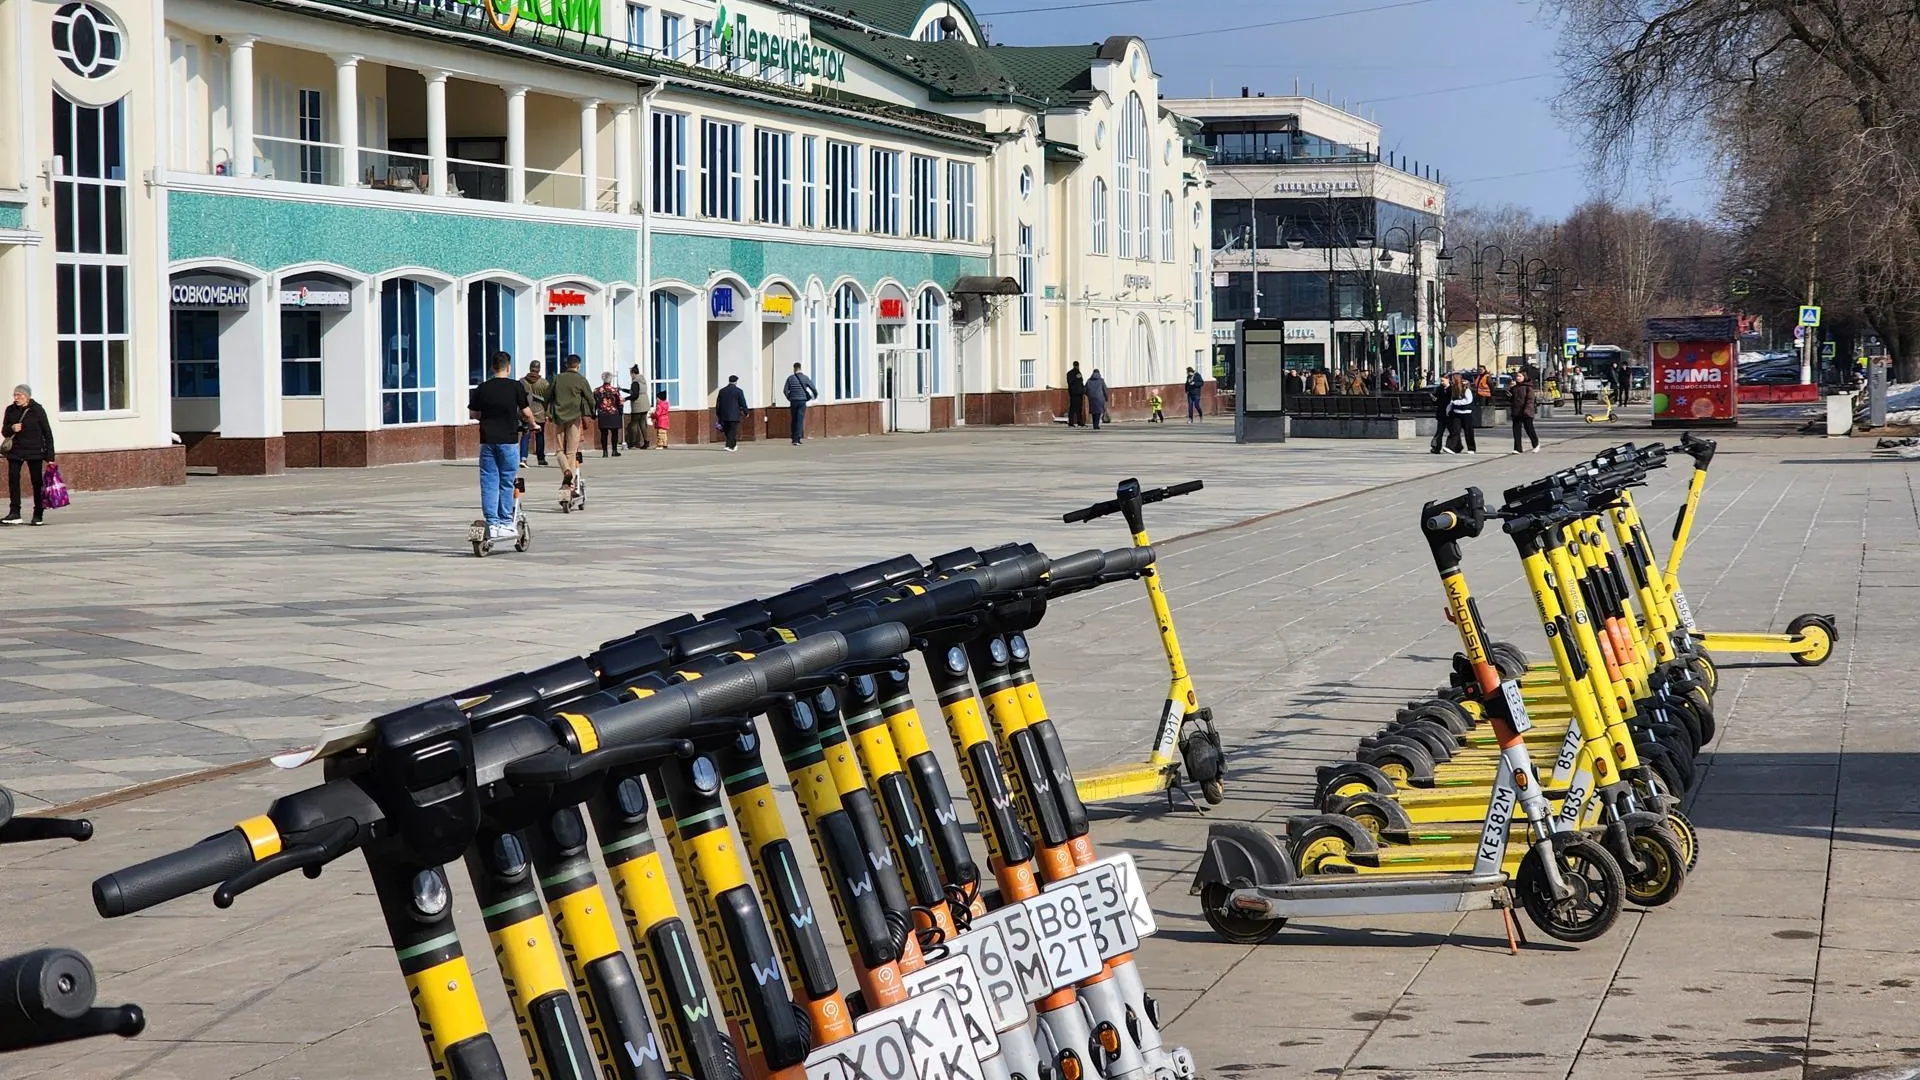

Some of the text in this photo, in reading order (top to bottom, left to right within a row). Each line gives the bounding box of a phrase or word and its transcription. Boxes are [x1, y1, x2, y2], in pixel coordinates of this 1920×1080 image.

[735, 13, 845, 86] Перекрёсток
[171, 285, 249, 304] СОВКОМБАНК
[1449, 581, 1482, 660] WHOOSH
[1545, 623, 1557, 637] Go
[1163, 713, 1179, 744] 0917
[1558, 731, 1581, 769] 8572
[946, 714, 997, 854] WHOOSH
[1560, 786, 1585, 824] 1835
[1481, 787, 1512, 861] KE382M
[996, 912, 1030, 951] 5
[1028, 896, 1081, 941] B8
[1049, 933, 1088, 978] 2T
[898, 998, 957, 1054] K1
